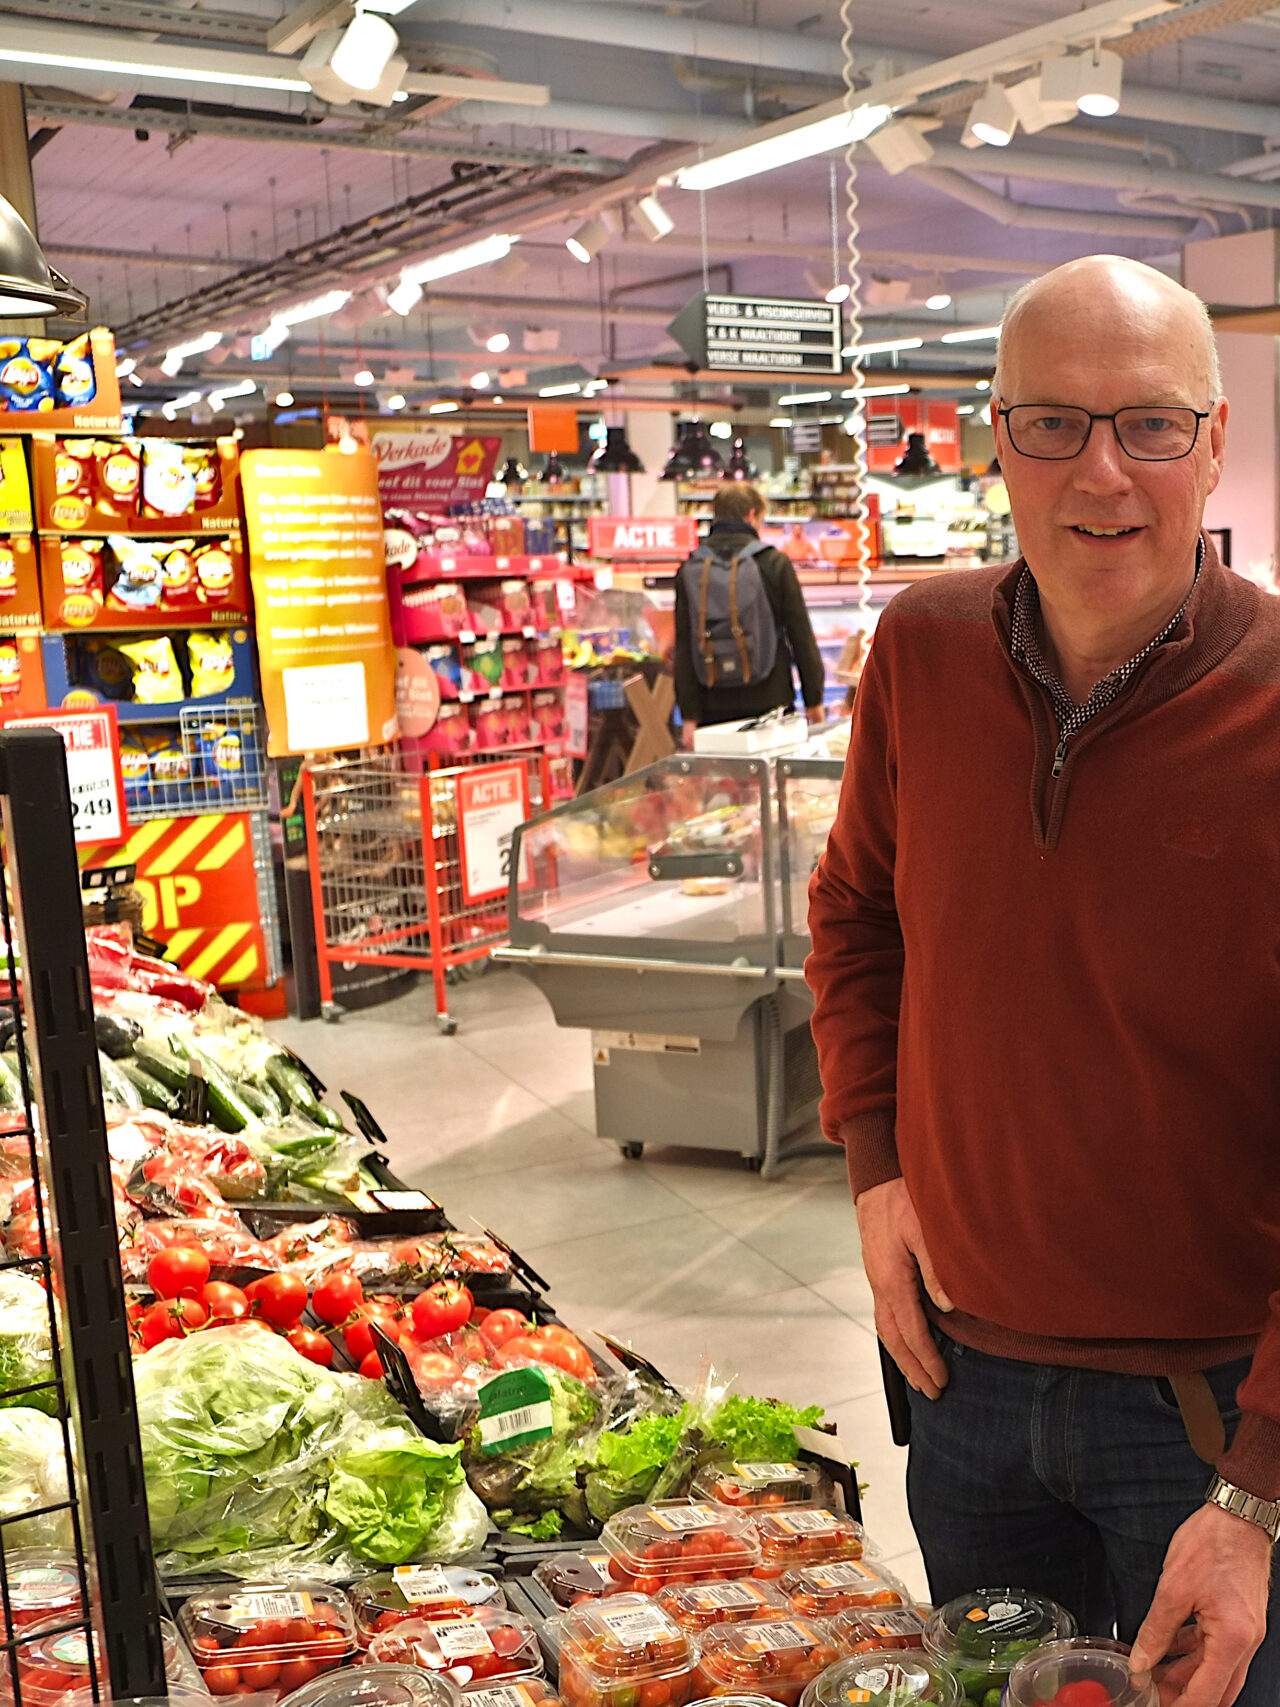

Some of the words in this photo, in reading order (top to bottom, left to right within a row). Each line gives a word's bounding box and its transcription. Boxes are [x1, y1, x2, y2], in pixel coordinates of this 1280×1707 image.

[73, 414, 120, 428] Naturel
[374, 438, 447, 460] Verkade
[401, 475, 421, 489] dit
[425, 477, 455, 488] voor
[456, 475, 486, 488] Sint
[613, 525, 676, 549] ACTIE
[61, 725, 94, 748] TIE
[471, 779, 513, 806] ACTIE
